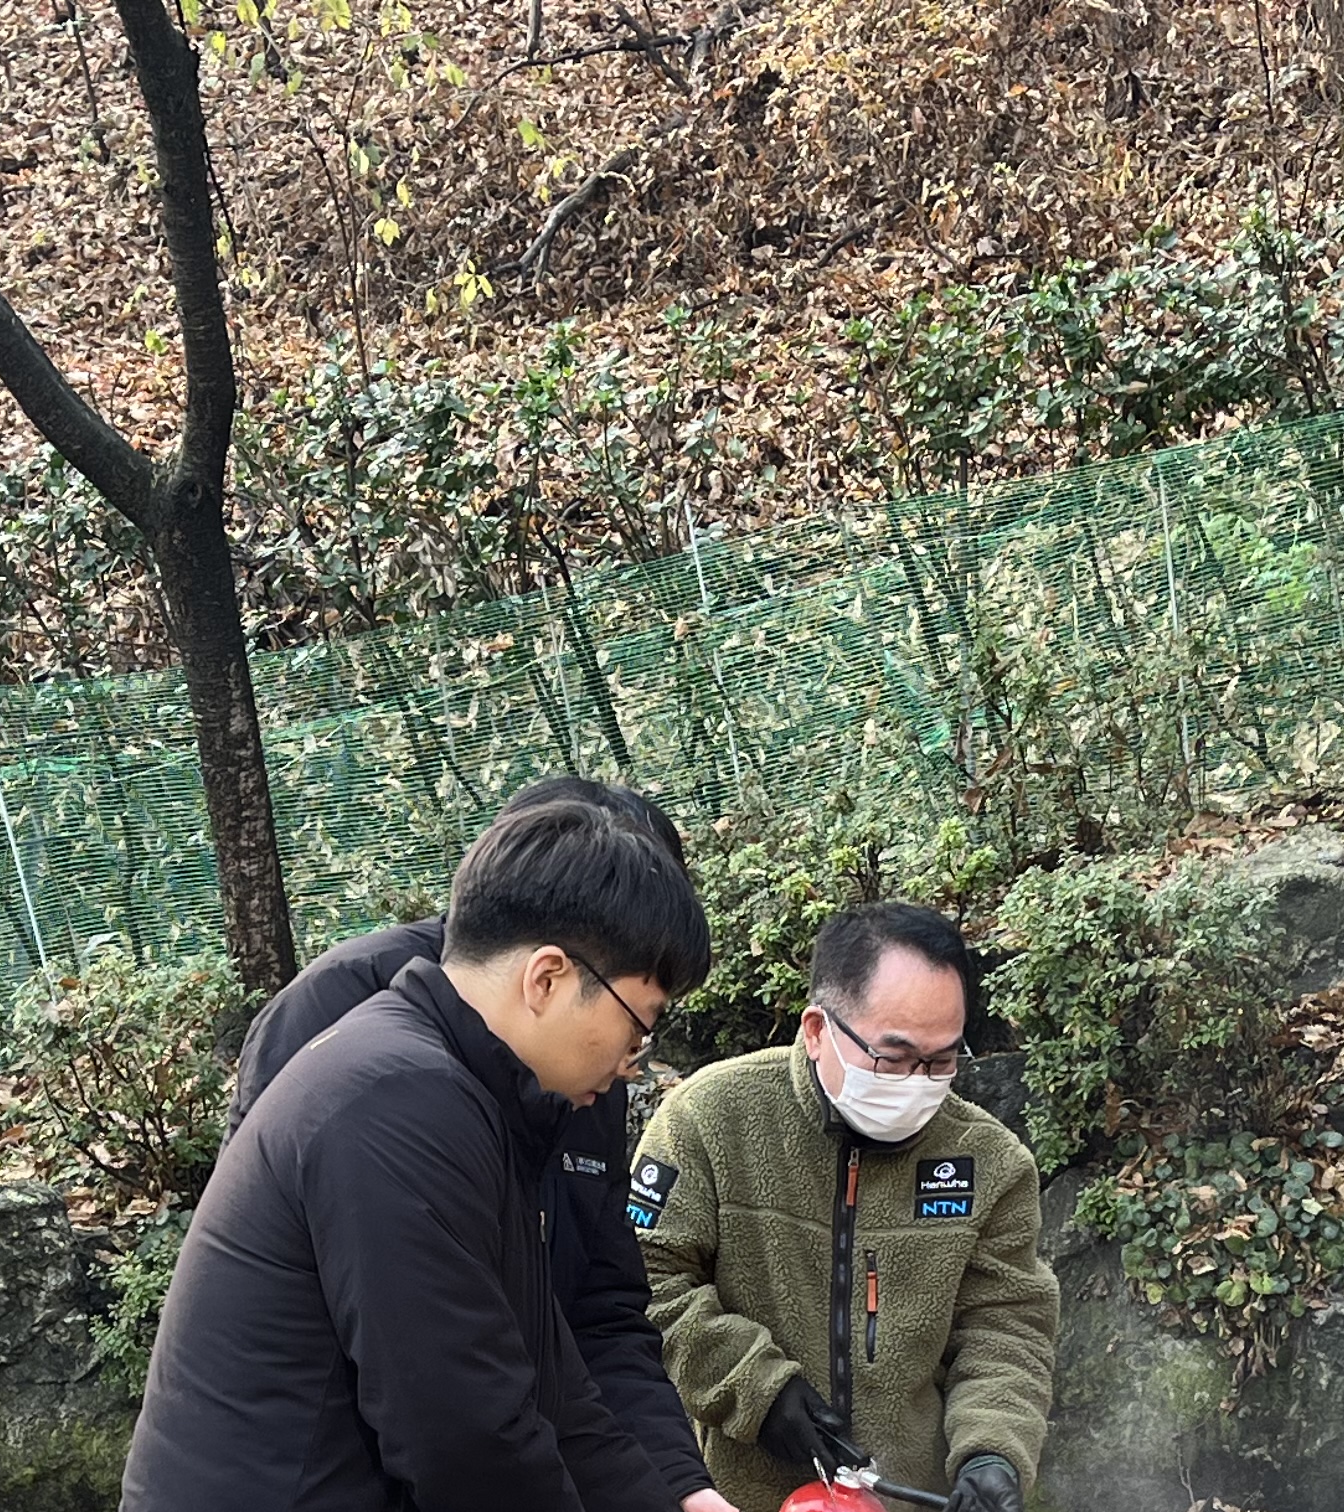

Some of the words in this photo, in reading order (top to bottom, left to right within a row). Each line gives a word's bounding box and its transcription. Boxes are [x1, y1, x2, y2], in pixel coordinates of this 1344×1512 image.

[920, 1179, 969, 1190] Hanwha
[626, 1203, 654, 1227] TN
[922, 1200, 967, 1216] NTN
